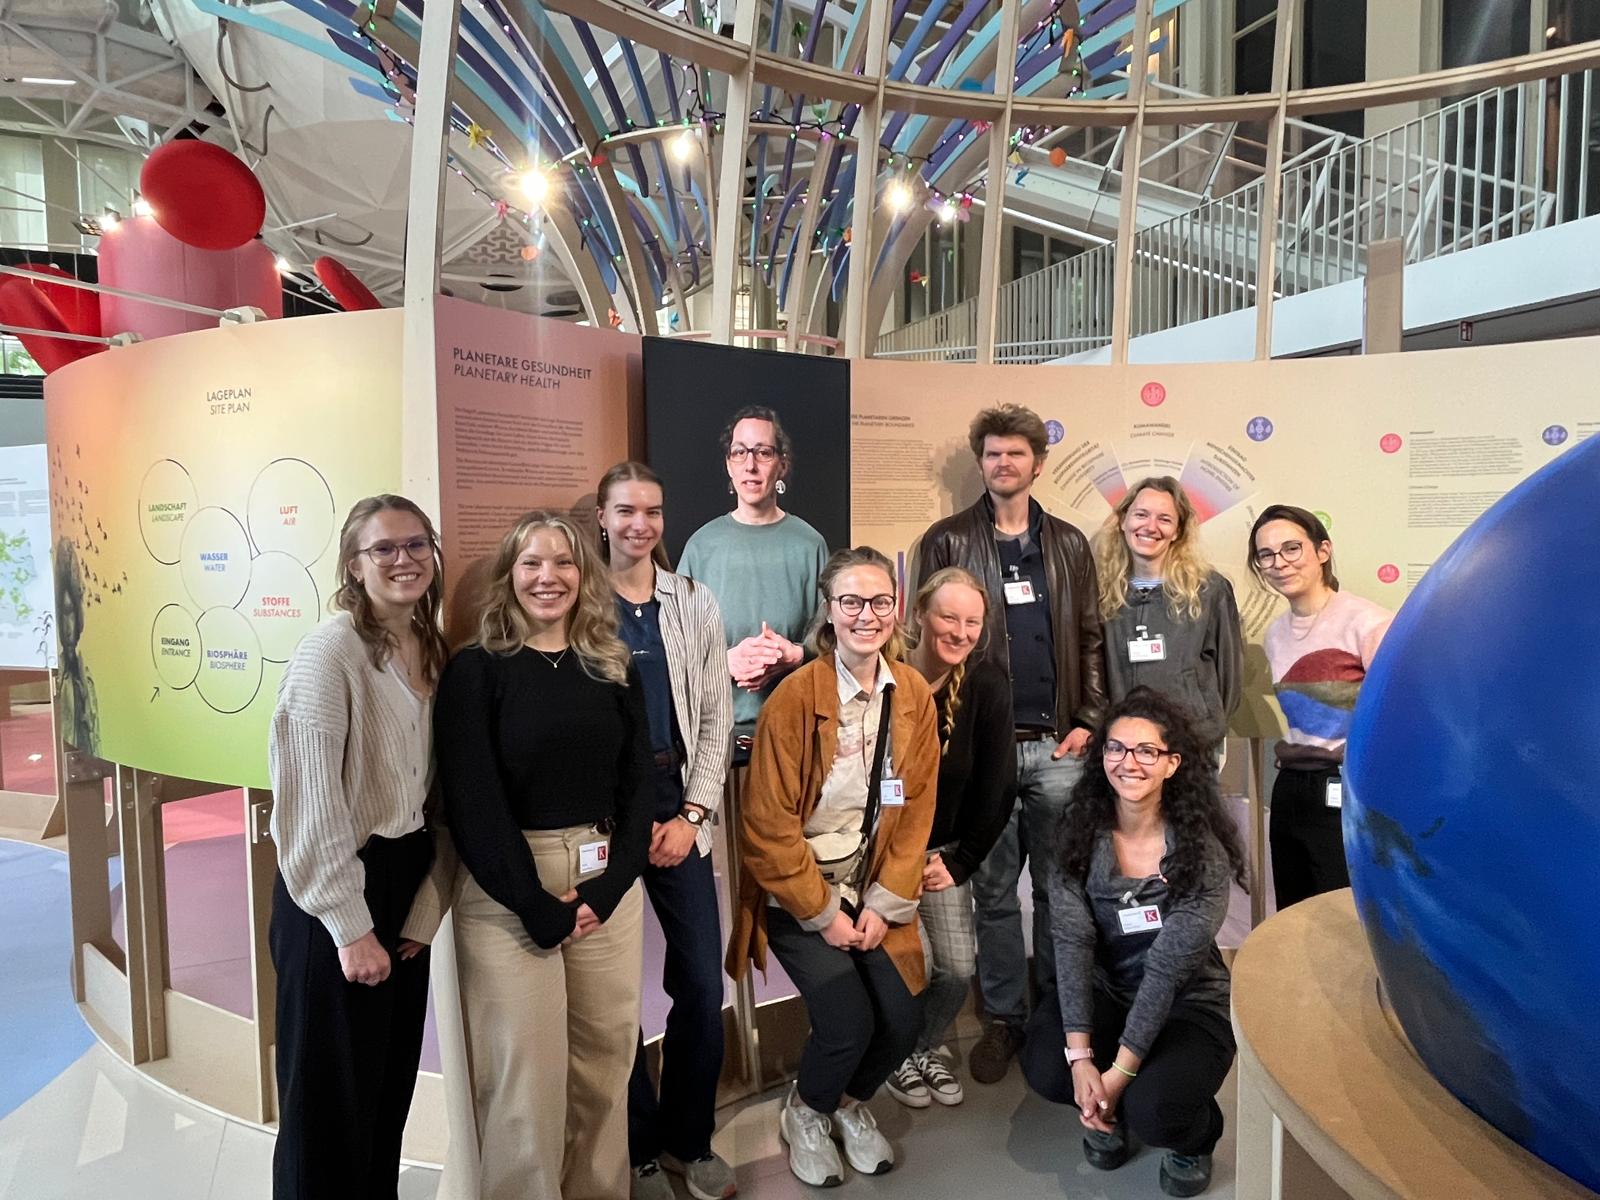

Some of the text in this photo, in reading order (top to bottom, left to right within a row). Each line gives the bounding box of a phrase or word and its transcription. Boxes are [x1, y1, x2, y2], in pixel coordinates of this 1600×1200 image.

[453, 347, 592, 380] PLANETARE GESUNDHEIT
[454, 363, 561, 390] PLANETARY HEALTH
[206, 388, 251, 402] LAGEPLAN
[210, 402, 250, 415] SITE PLAN
[148, 502, 187, 512] LANDSCHAFT
[279, 505, 298, 515] LUFT
[151, 513, 184, 523] LANDSCAPE
[282, 517, 296, 526] AIR
[200, 552, 228, 561] WASSER
[204, 563, 226, 572] WATER
[262, 597, 290, 606] STOFFE
[253, 608, 301, 618] SUBSTANCES
[161, 637, 190, 647] EINGANG
[161, 647, 191, 658] ENTRANCE
[206, 648, 248, 660] BIOSPHÄRE
[209, 660, 245, 671] BIOSPHERE
